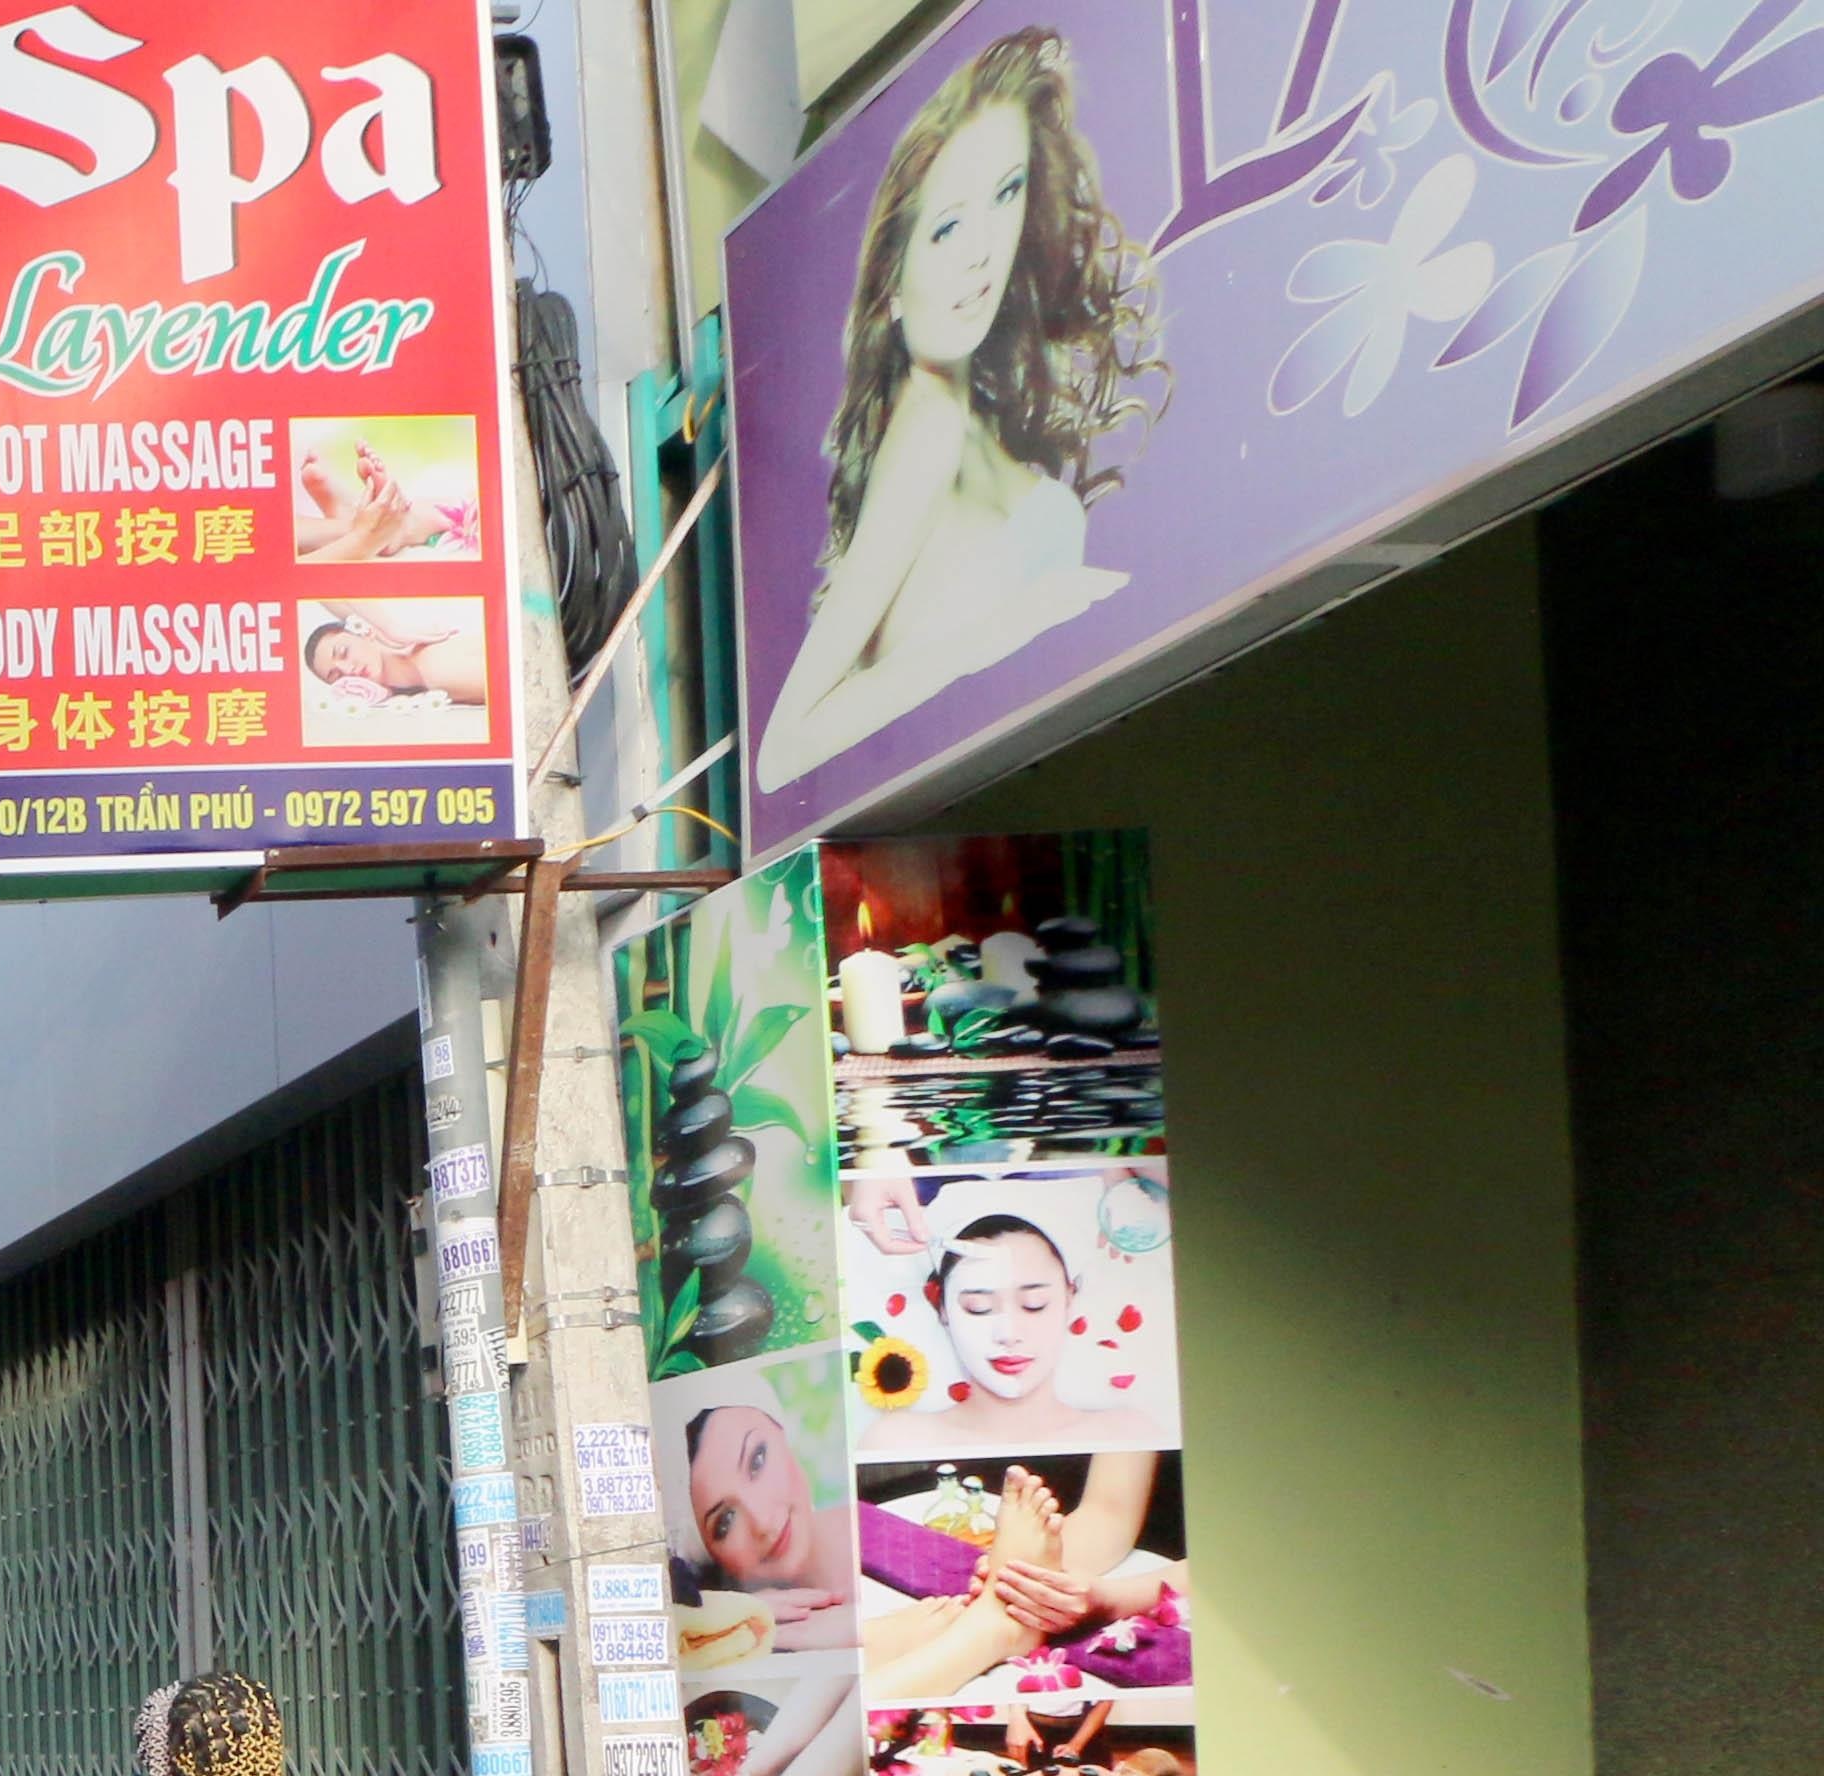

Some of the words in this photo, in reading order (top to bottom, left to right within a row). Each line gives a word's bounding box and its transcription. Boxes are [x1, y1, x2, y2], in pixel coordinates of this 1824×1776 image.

[61, 419, 276, 493] MASSAGE
[74, 601, 285, 676] MASSAGE
[96, 781, 183, 834] TRẦN
[190, 785, 253, 831] PHÚ
[286, 791, 363, 829] 0972
[371, 789, 430, 827] 597
[438, 786, 496, 826] 095
[592, 1578, 660, 1600] 3.888.272
